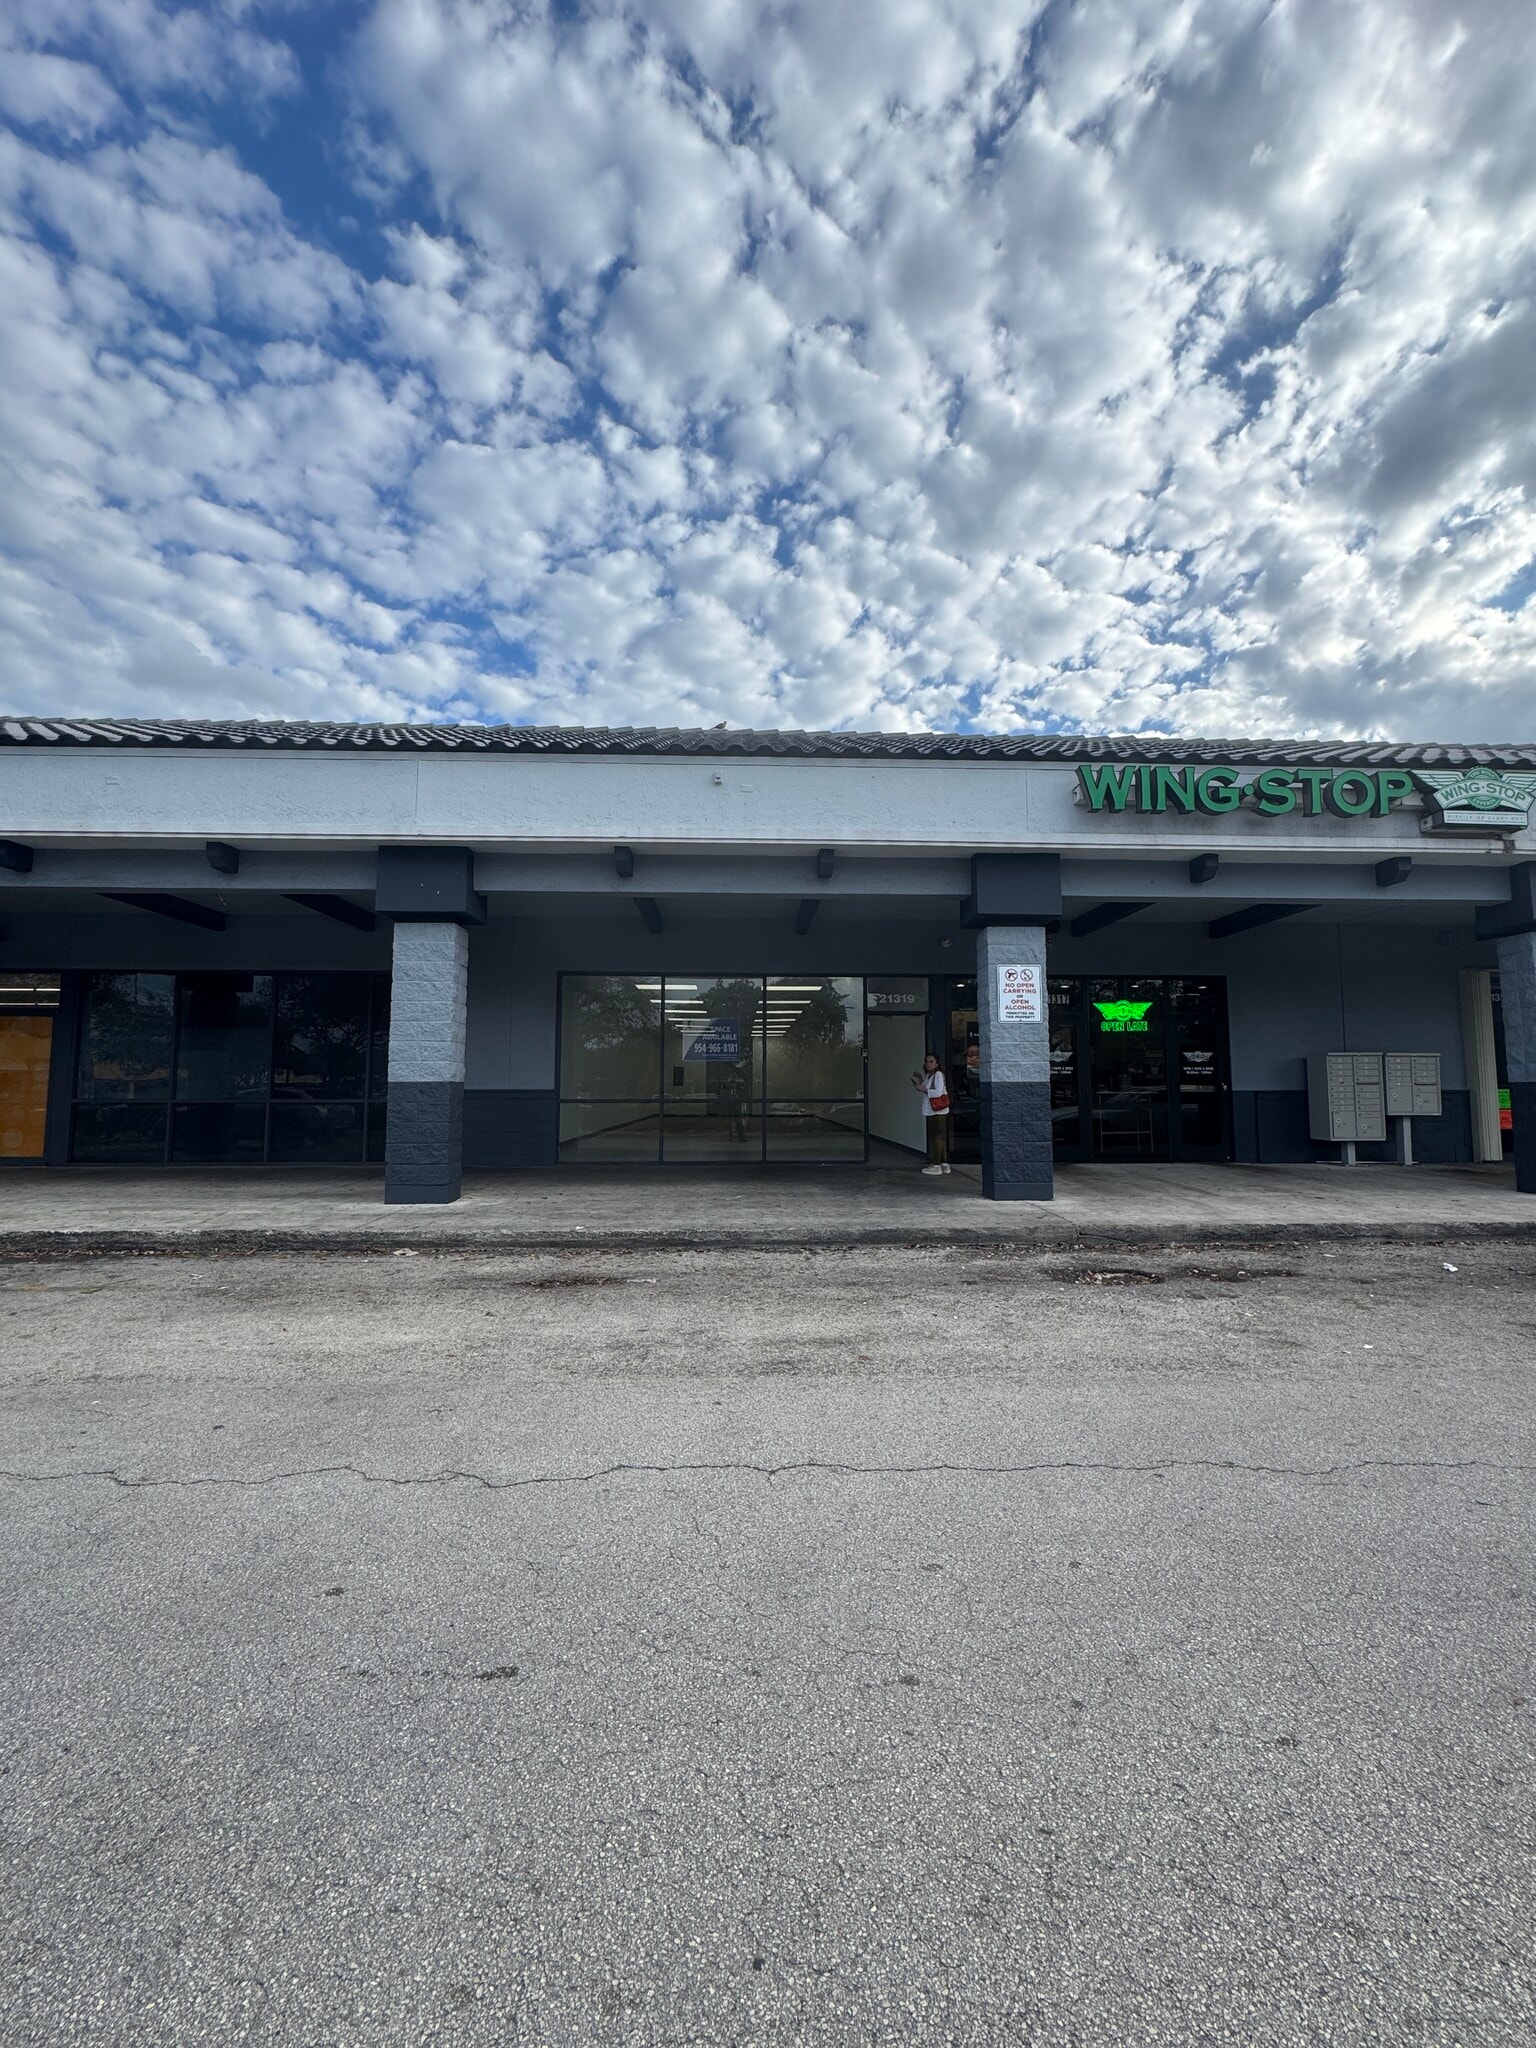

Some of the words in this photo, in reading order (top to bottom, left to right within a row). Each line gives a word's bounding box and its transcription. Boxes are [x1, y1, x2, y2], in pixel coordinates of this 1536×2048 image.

[879, 993, 915, 1004] 21319
[1101, 1021, 1125, 1031] OPEN
[1127, 1021, 1148, 1031] LATE
[694, 1043, 738, 1053] 954-966-8181
